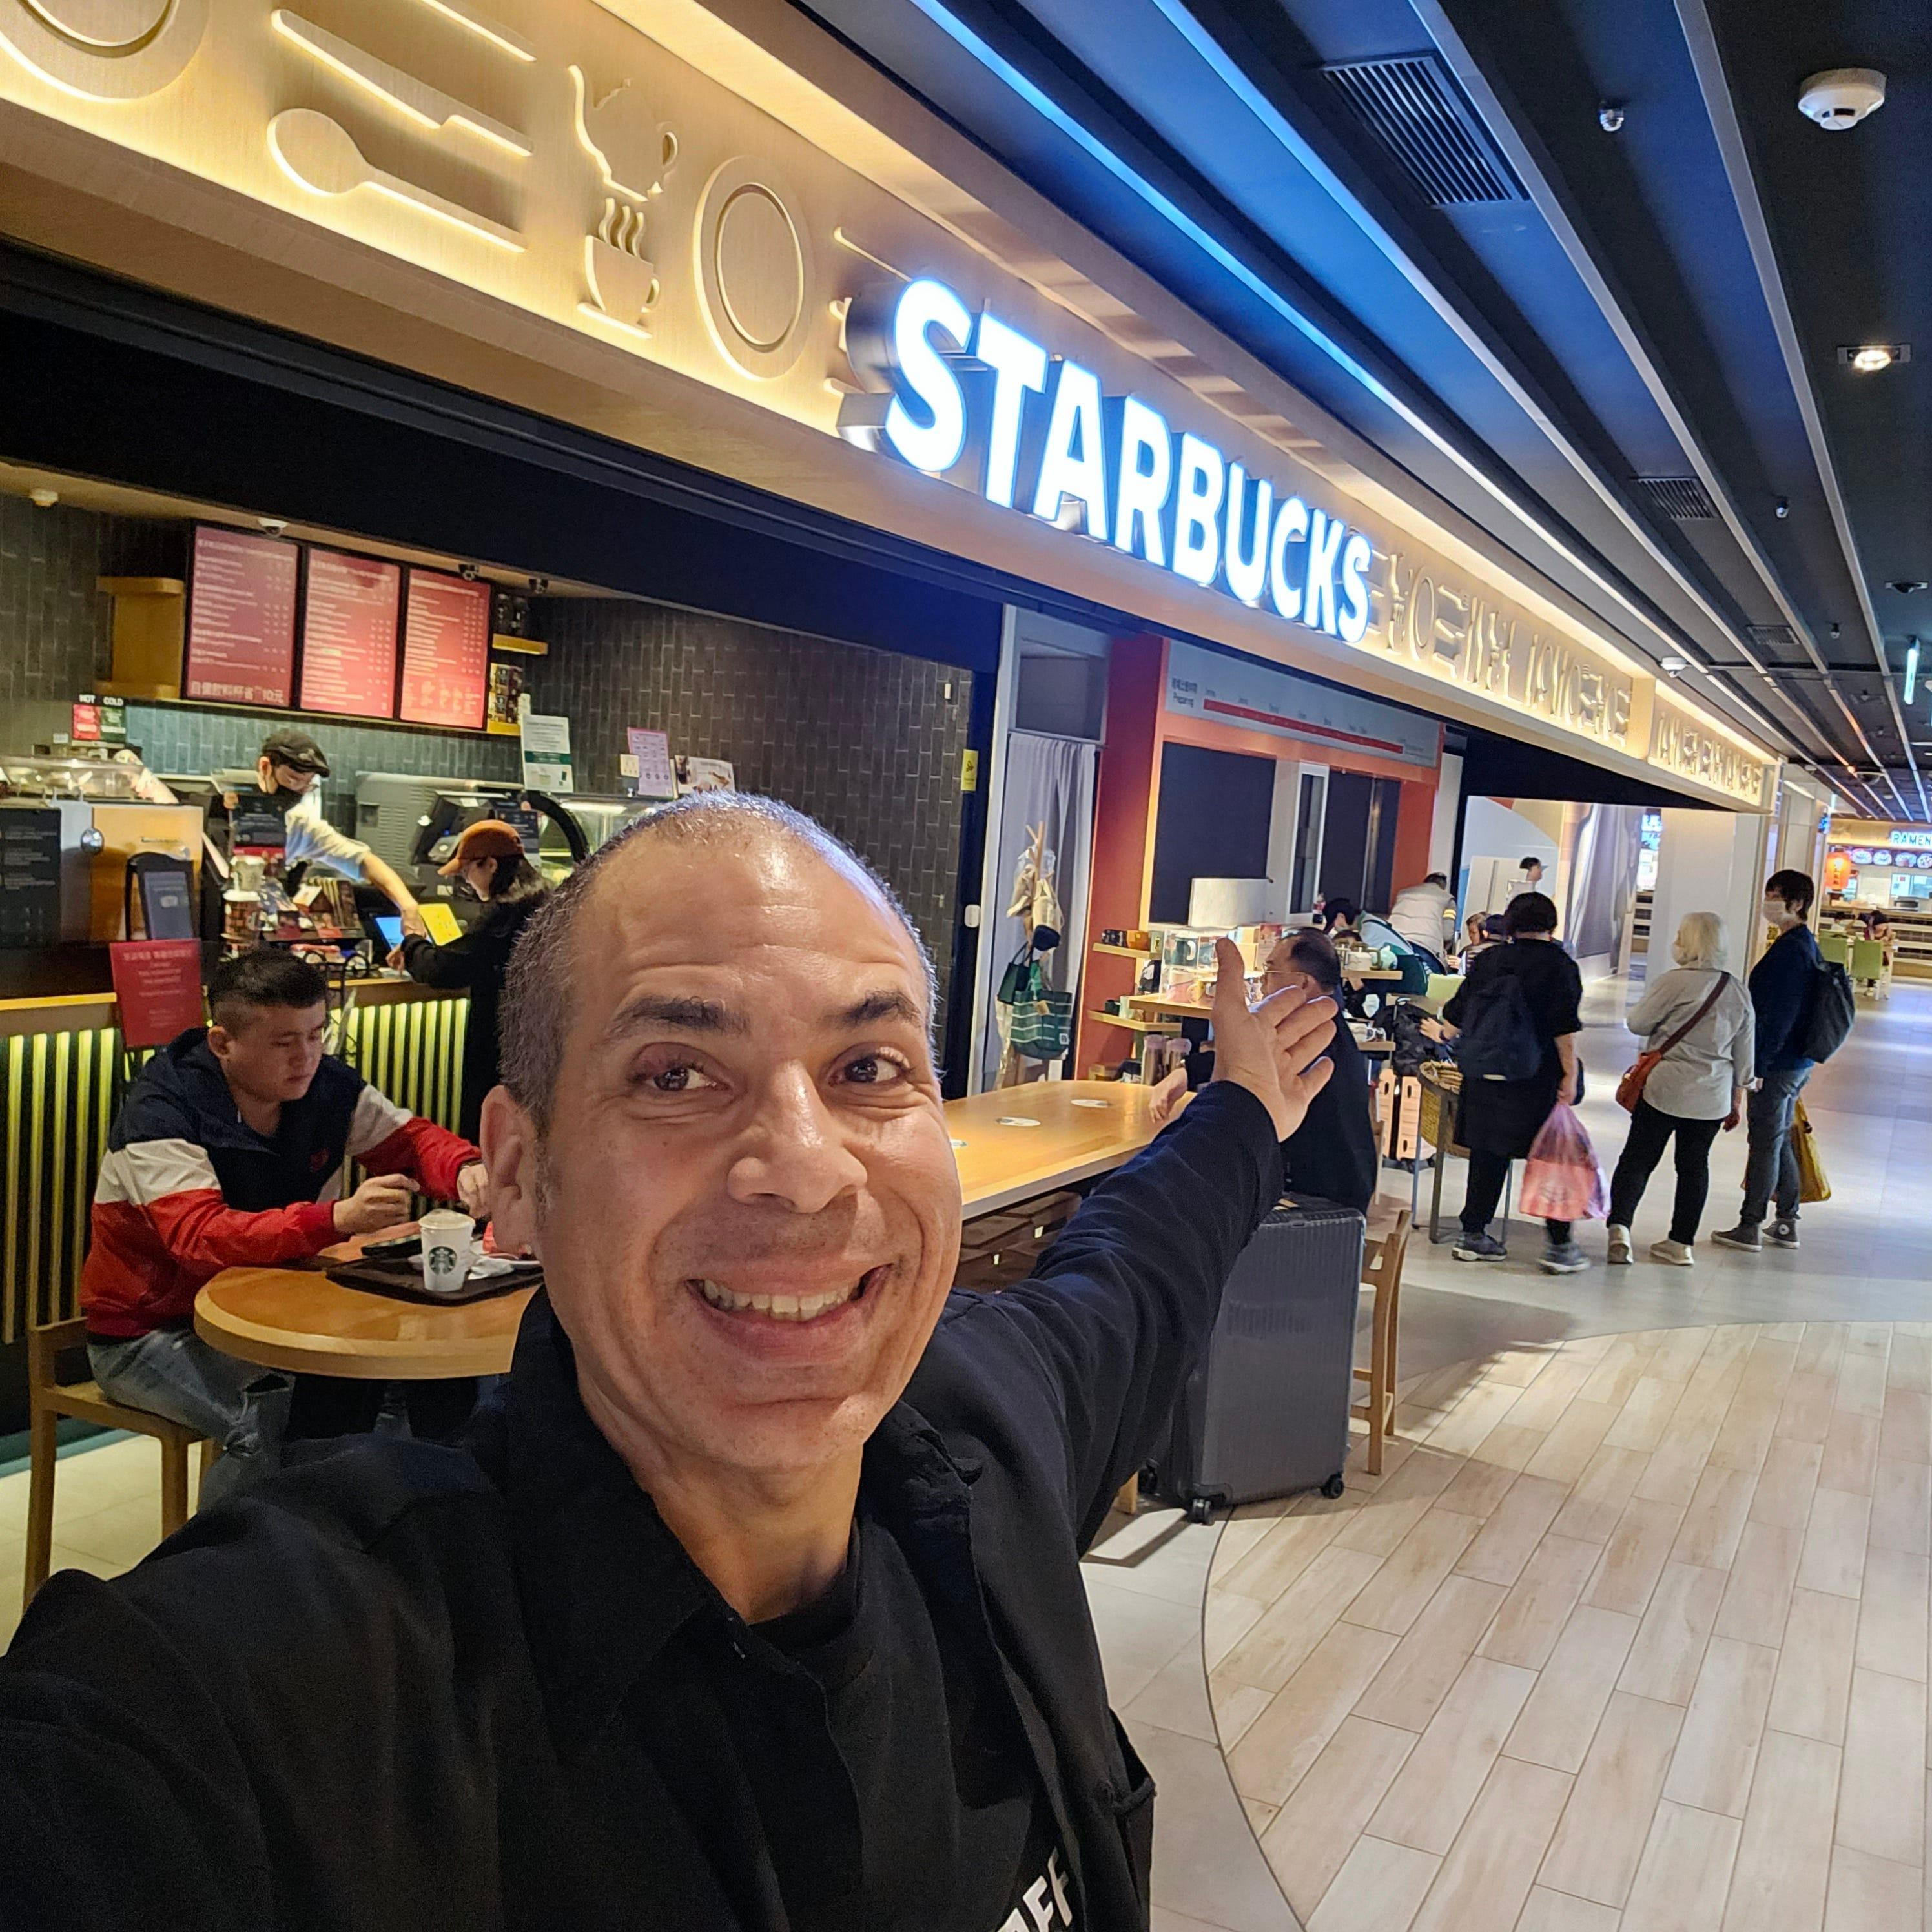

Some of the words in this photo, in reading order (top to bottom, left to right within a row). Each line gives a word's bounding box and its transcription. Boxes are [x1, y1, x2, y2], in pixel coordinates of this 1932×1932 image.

[886, 278, 1372, 643] STARBUCKS
[79, 694, 96, 704] HOT
[103, 697, 124, 706] COLD
[1893, 833, 1931, 846] RAMEN
